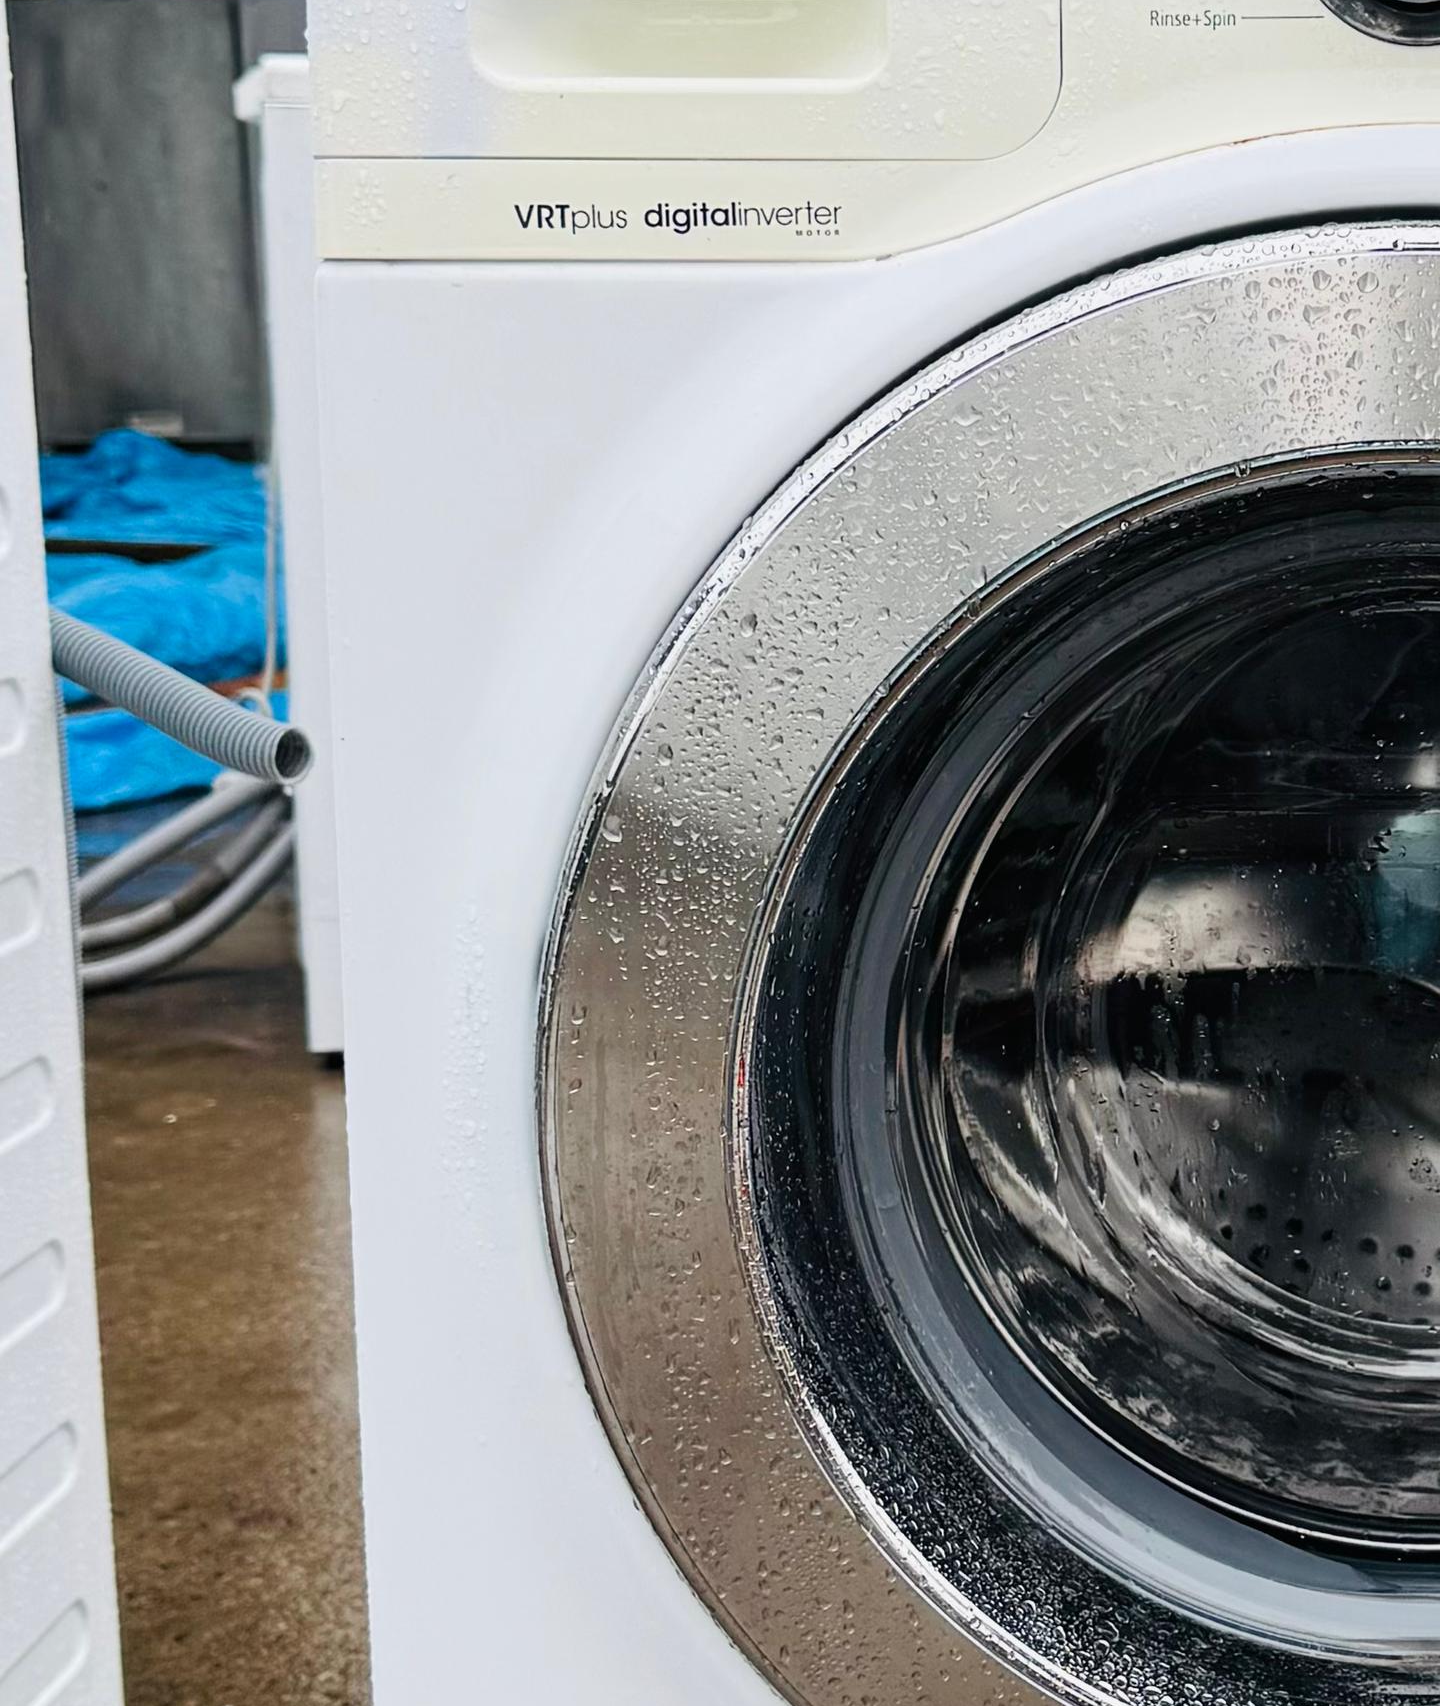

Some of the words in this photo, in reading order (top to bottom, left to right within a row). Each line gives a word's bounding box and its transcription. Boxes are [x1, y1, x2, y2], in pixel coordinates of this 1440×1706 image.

[1149, 9, 1236, 31] Rinse+Spin
[514, 203, 628, 235] VRTplus
[795, 229, 840, 237] MOTOR
